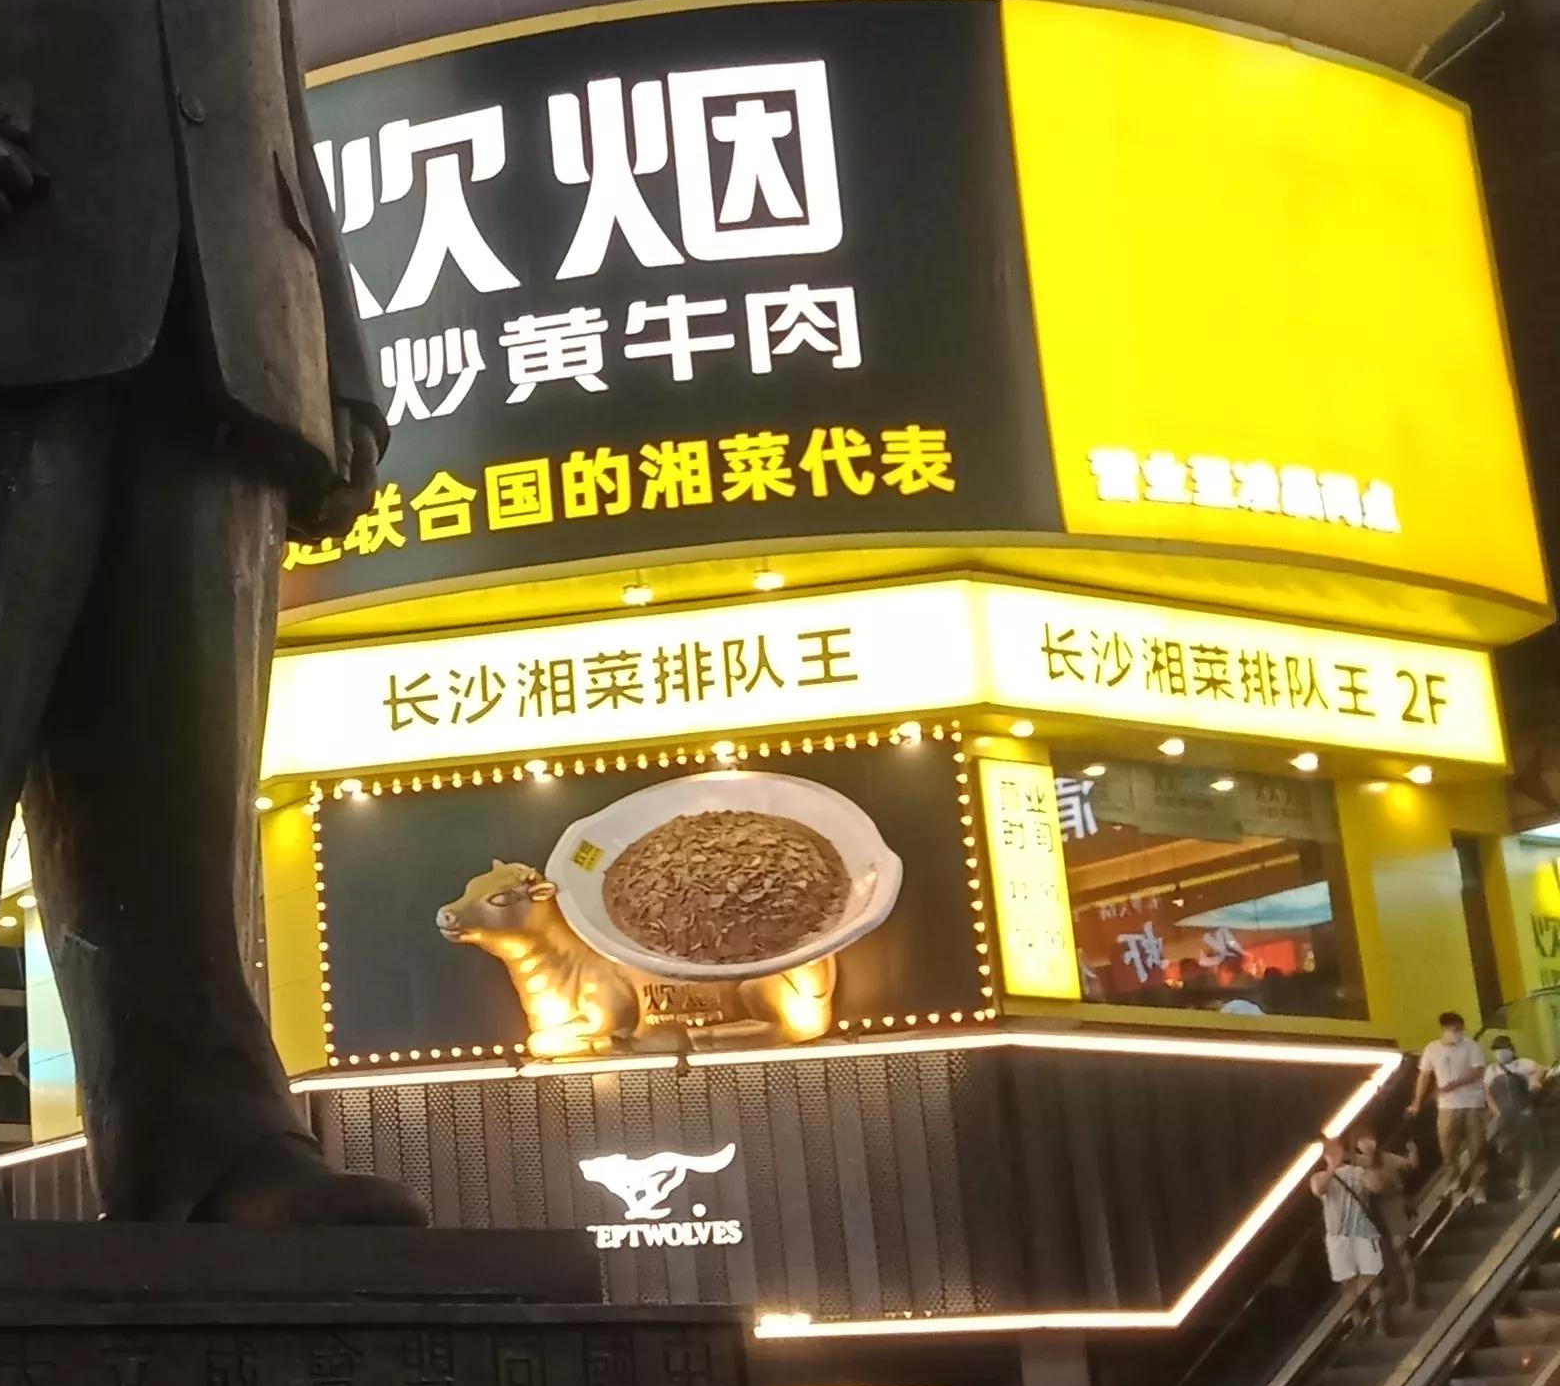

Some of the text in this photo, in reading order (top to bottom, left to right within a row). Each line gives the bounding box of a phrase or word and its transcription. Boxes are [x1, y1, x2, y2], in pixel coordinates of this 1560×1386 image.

[380, 283, 863, 425] 炒黄牛肉
[383, 627, 860, 732] 长沙湘菜排队王
[1040, 622, 1447, 725] 长沙湘菜排队王 2F
[587, 1220, 743, 1250] EPTWOLVES
